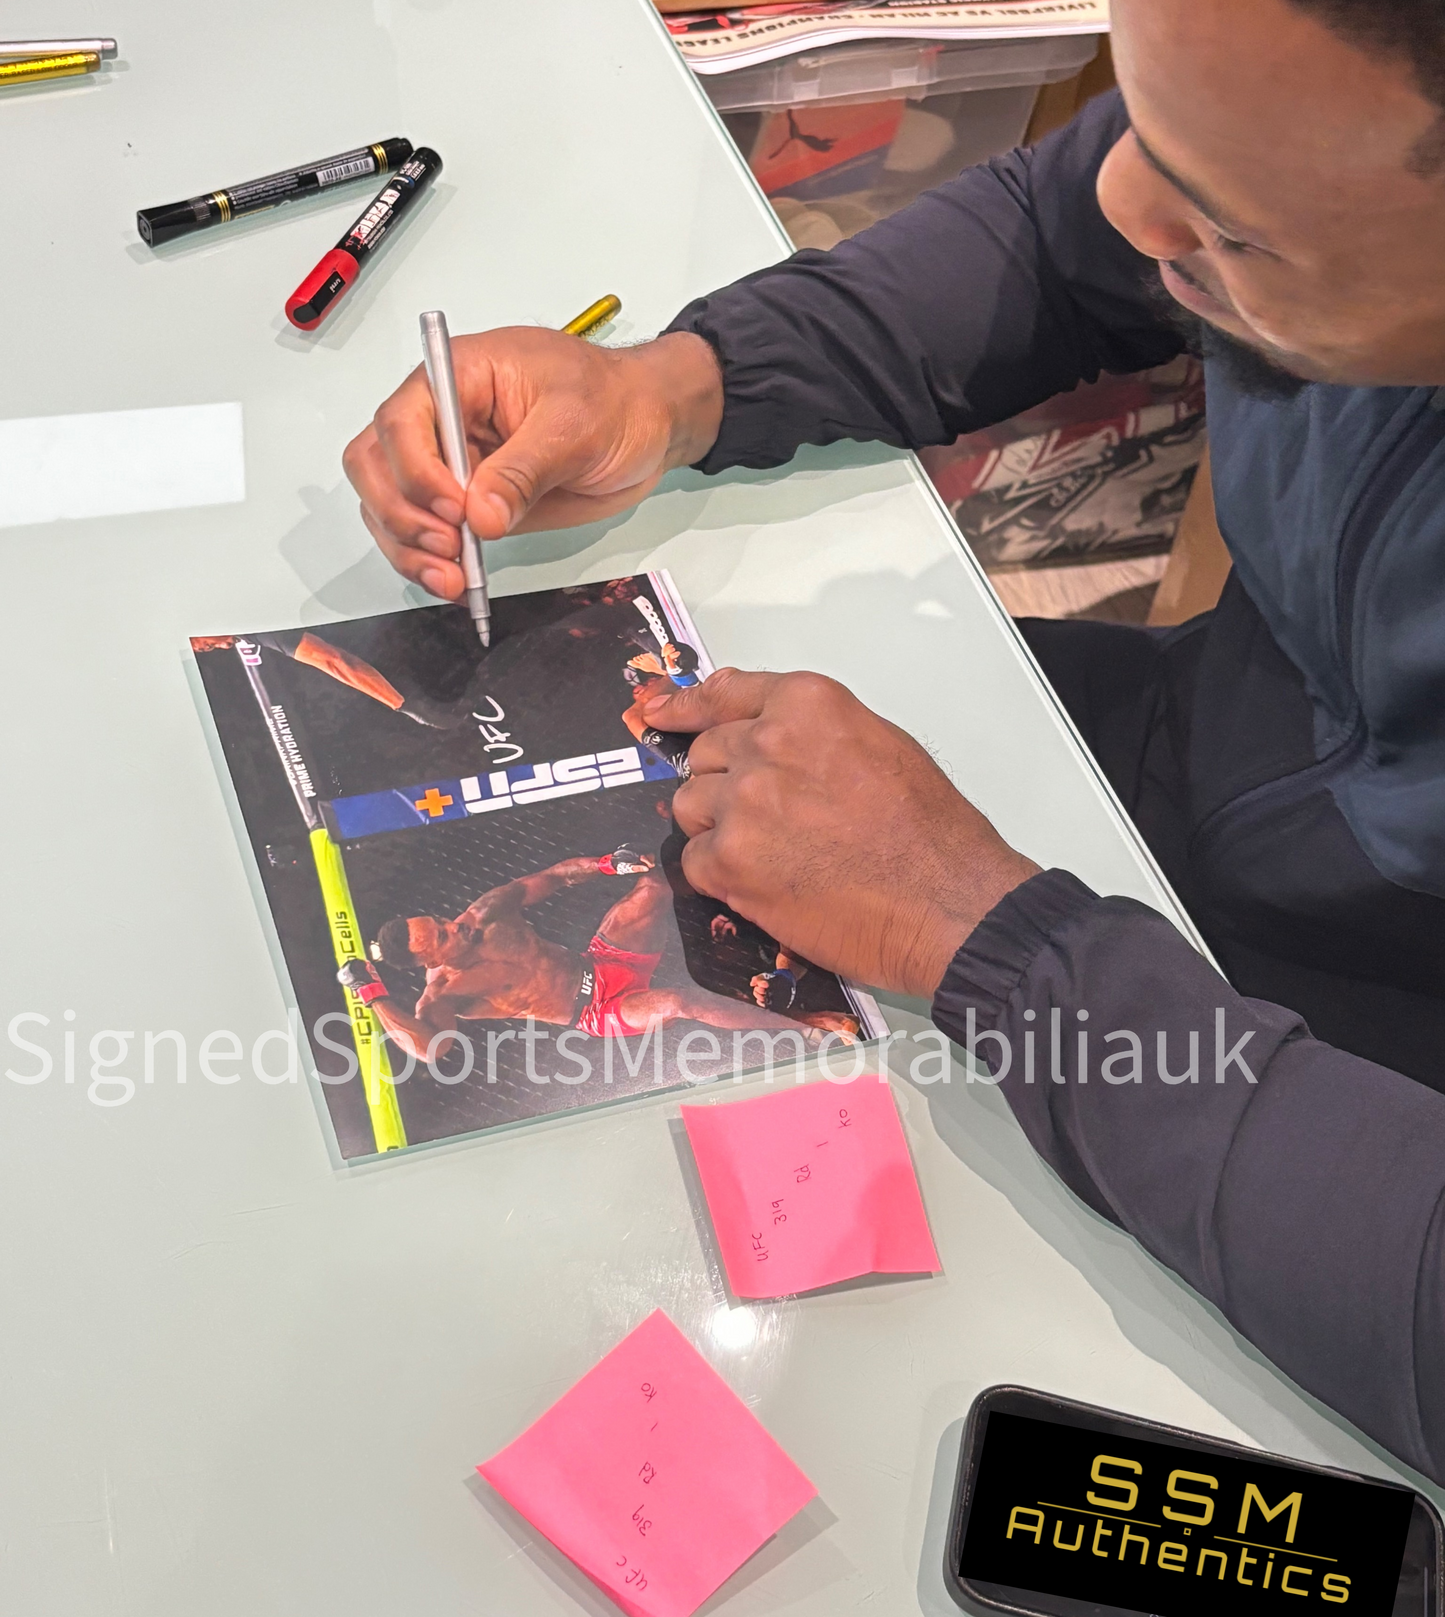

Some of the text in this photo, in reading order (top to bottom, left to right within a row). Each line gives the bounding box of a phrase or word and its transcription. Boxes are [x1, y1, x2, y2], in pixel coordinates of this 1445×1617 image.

[995, 2, 1097, 16] LIVERPOOL
[736, 14, 855, 39] CHAMPIONS
[329, 278, 341, 293] uni
[270, 705, 303, 763] HYDRATION
[472, 695, 524, 764] UFC
[293, 763, 317, 798] PRIME
[581, 970, 593, 995] UFC
[752, 1232, 769, 1262] UFC
[772, 1198, 787, 1225] 319
[794, 1163, 812, 1183] Rd
[838, 1108, 852, 1129] KO
[638, 1461, 658, 1484] Rd
[632, 1504, 652, 1537] 319
